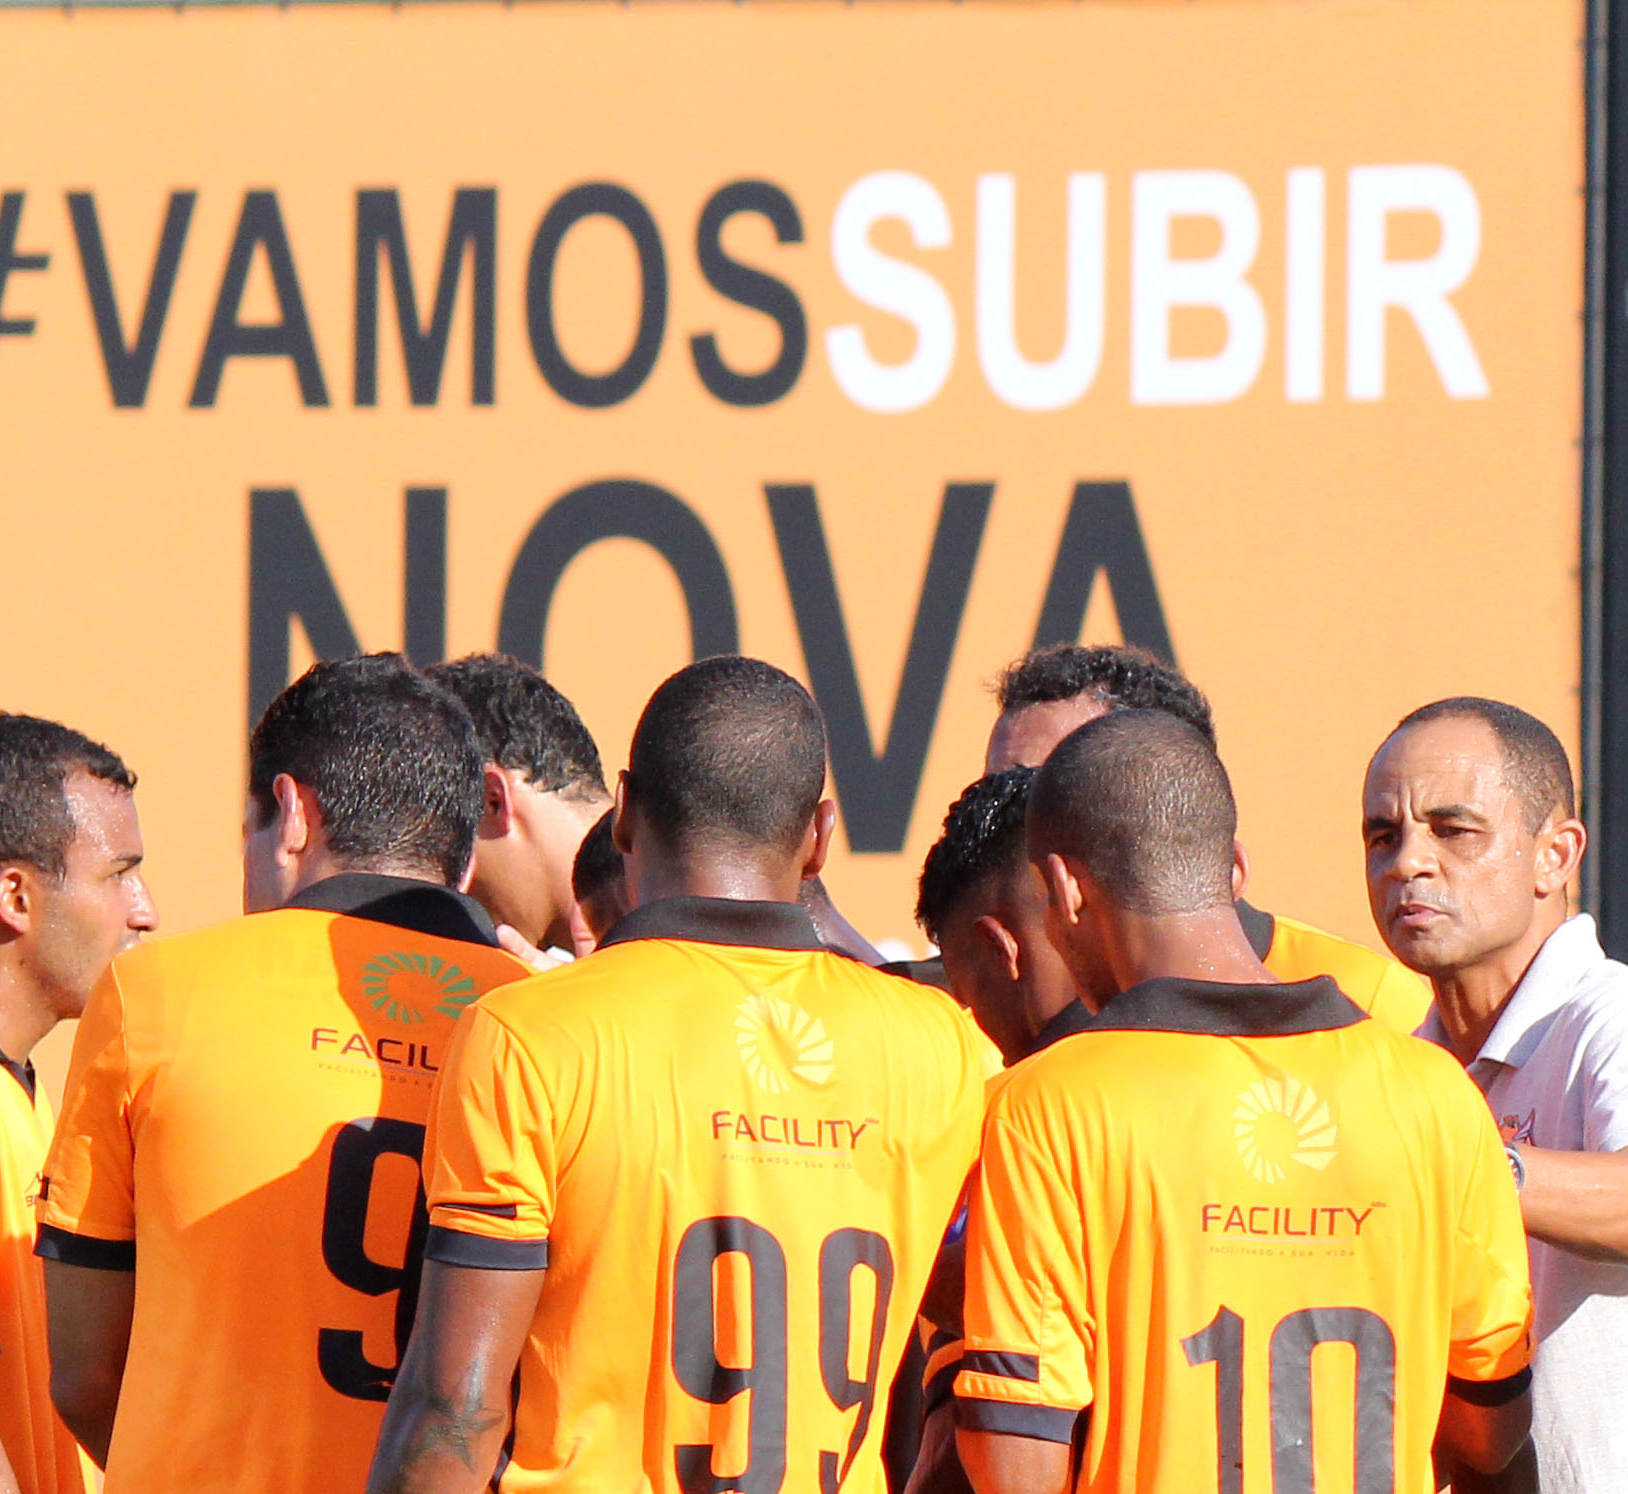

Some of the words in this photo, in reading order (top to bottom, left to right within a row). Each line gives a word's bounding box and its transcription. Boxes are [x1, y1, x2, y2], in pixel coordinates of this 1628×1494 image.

[246, 476, 1187, 855] NOVA
[310, 1027, 439, 1072] FACIL
[711, 1110, 868, 1150] FACILITY
[1201, 1203, 1373, 1236] FACILITY
